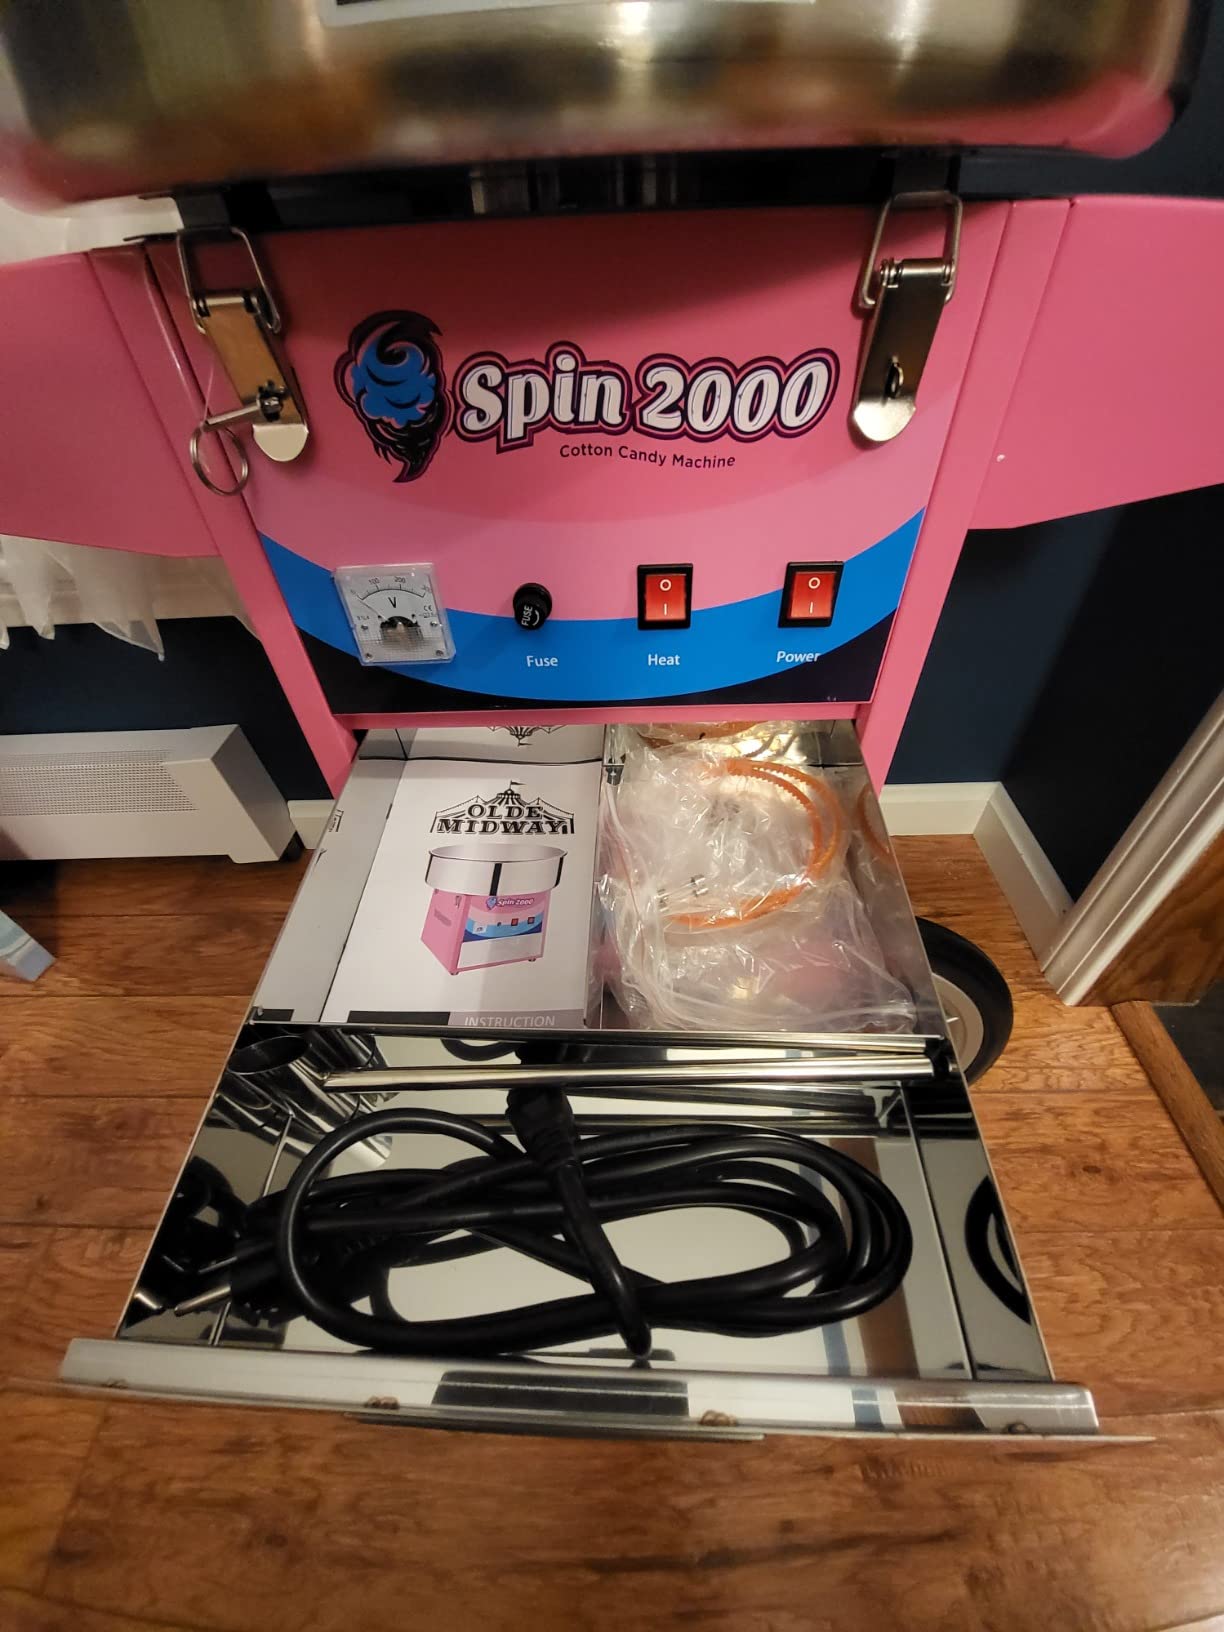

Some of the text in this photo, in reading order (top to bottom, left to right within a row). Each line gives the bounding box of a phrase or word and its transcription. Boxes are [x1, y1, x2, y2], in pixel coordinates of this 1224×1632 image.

[459, 349, 832, 443] Spin 2000
[559, 443, 737, 470] Cotton Candy Machine
[387, 596, 397, 609] V
[520, 604, 533, 626] FUSE
[525, 654, 559, 668] Fuse
[647, 653, 681, 667] Heat
[776, 650, 822, 664] Power
[467, 804, 544, 820] OLDE
[437, 818, 567, 835] MIDWAY
[463, 1015, 557, 1028] INSTRUCTION
